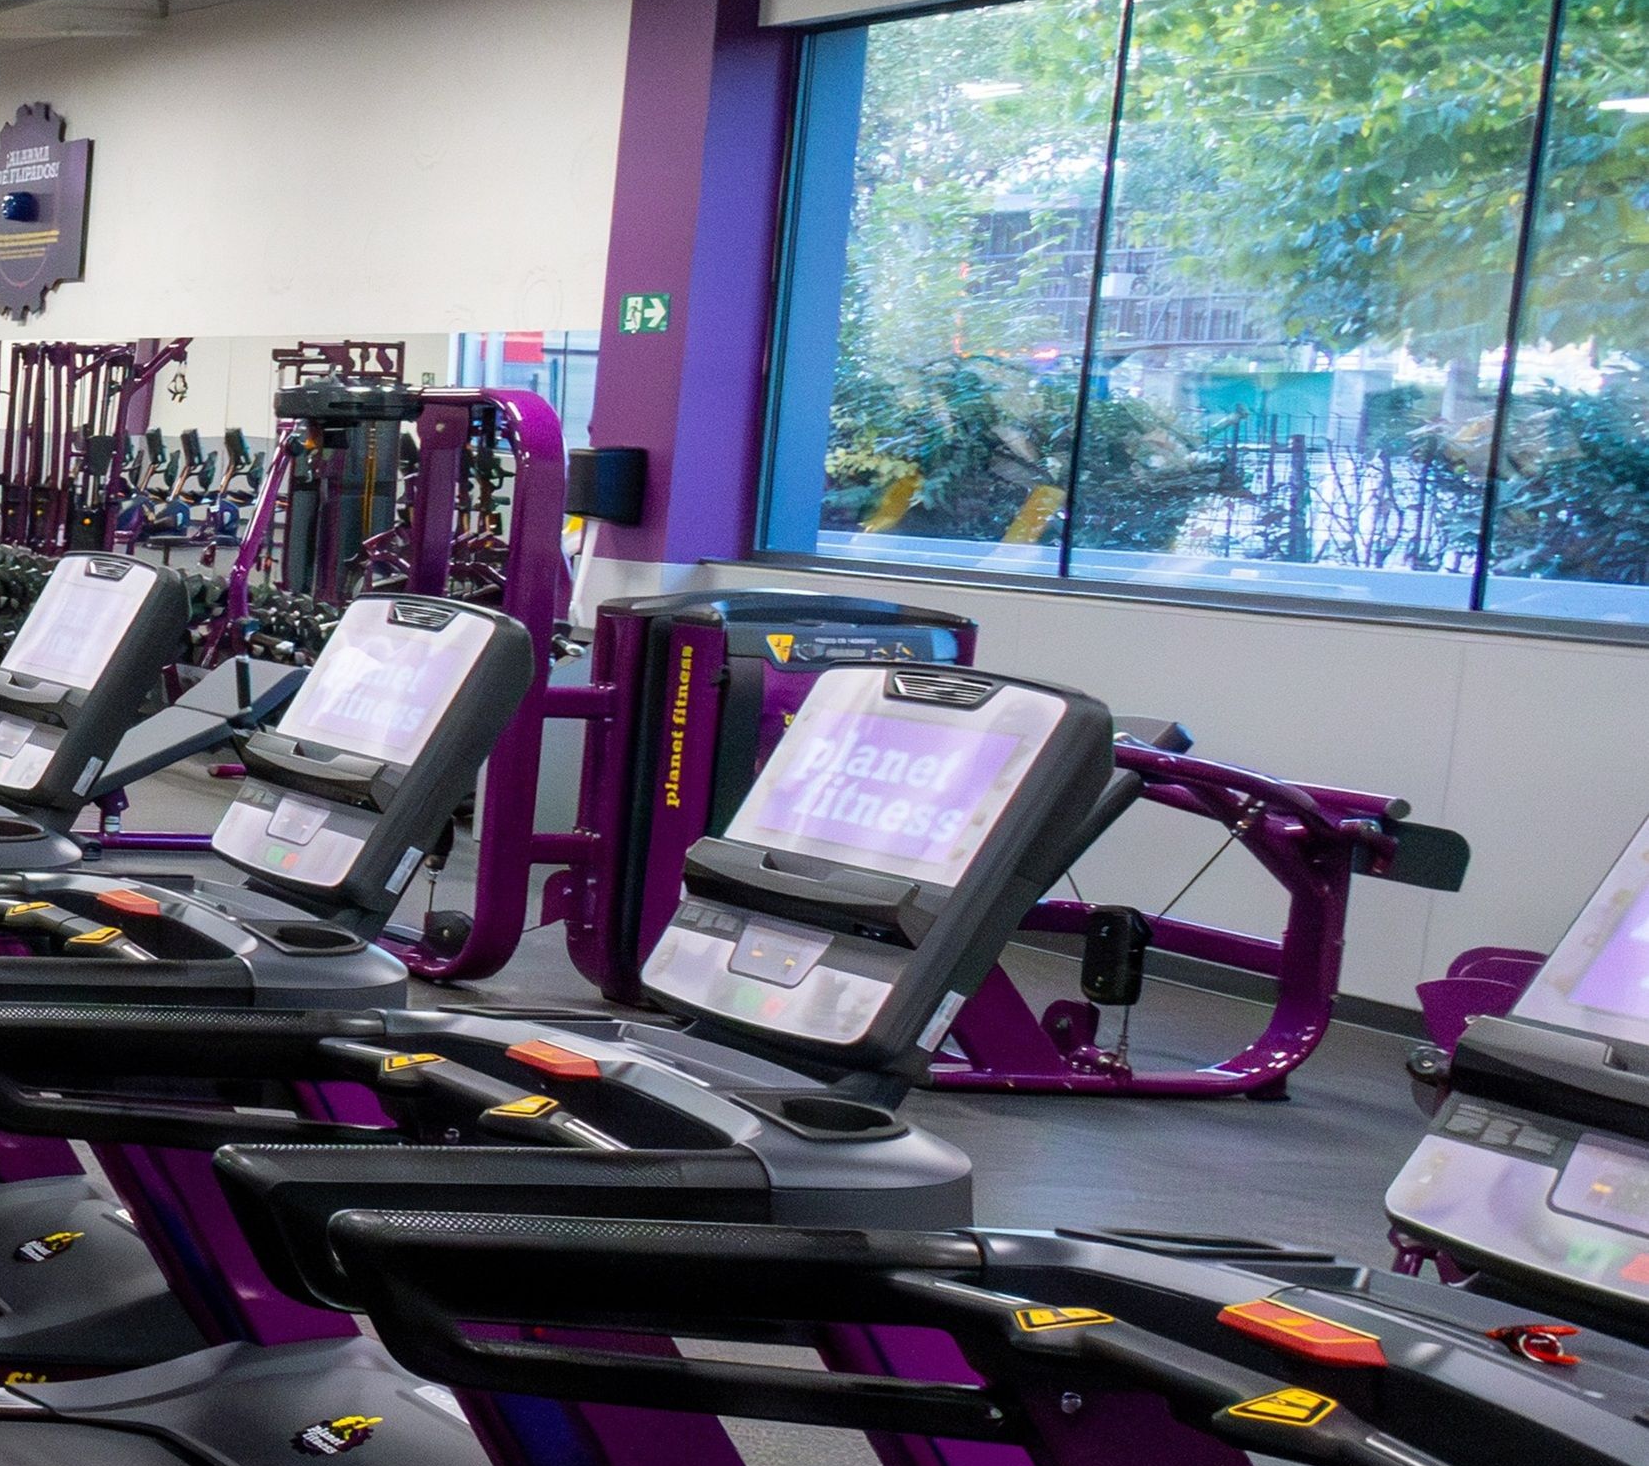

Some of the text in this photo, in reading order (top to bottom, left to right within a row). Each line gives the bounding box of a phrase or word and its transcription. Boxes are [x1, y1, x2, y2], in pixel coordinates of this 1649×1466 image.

[665, 645, 694, 808] planet fitness
[793, 729, 964, 792] planet
[792, 771, 965, 844] fitness
